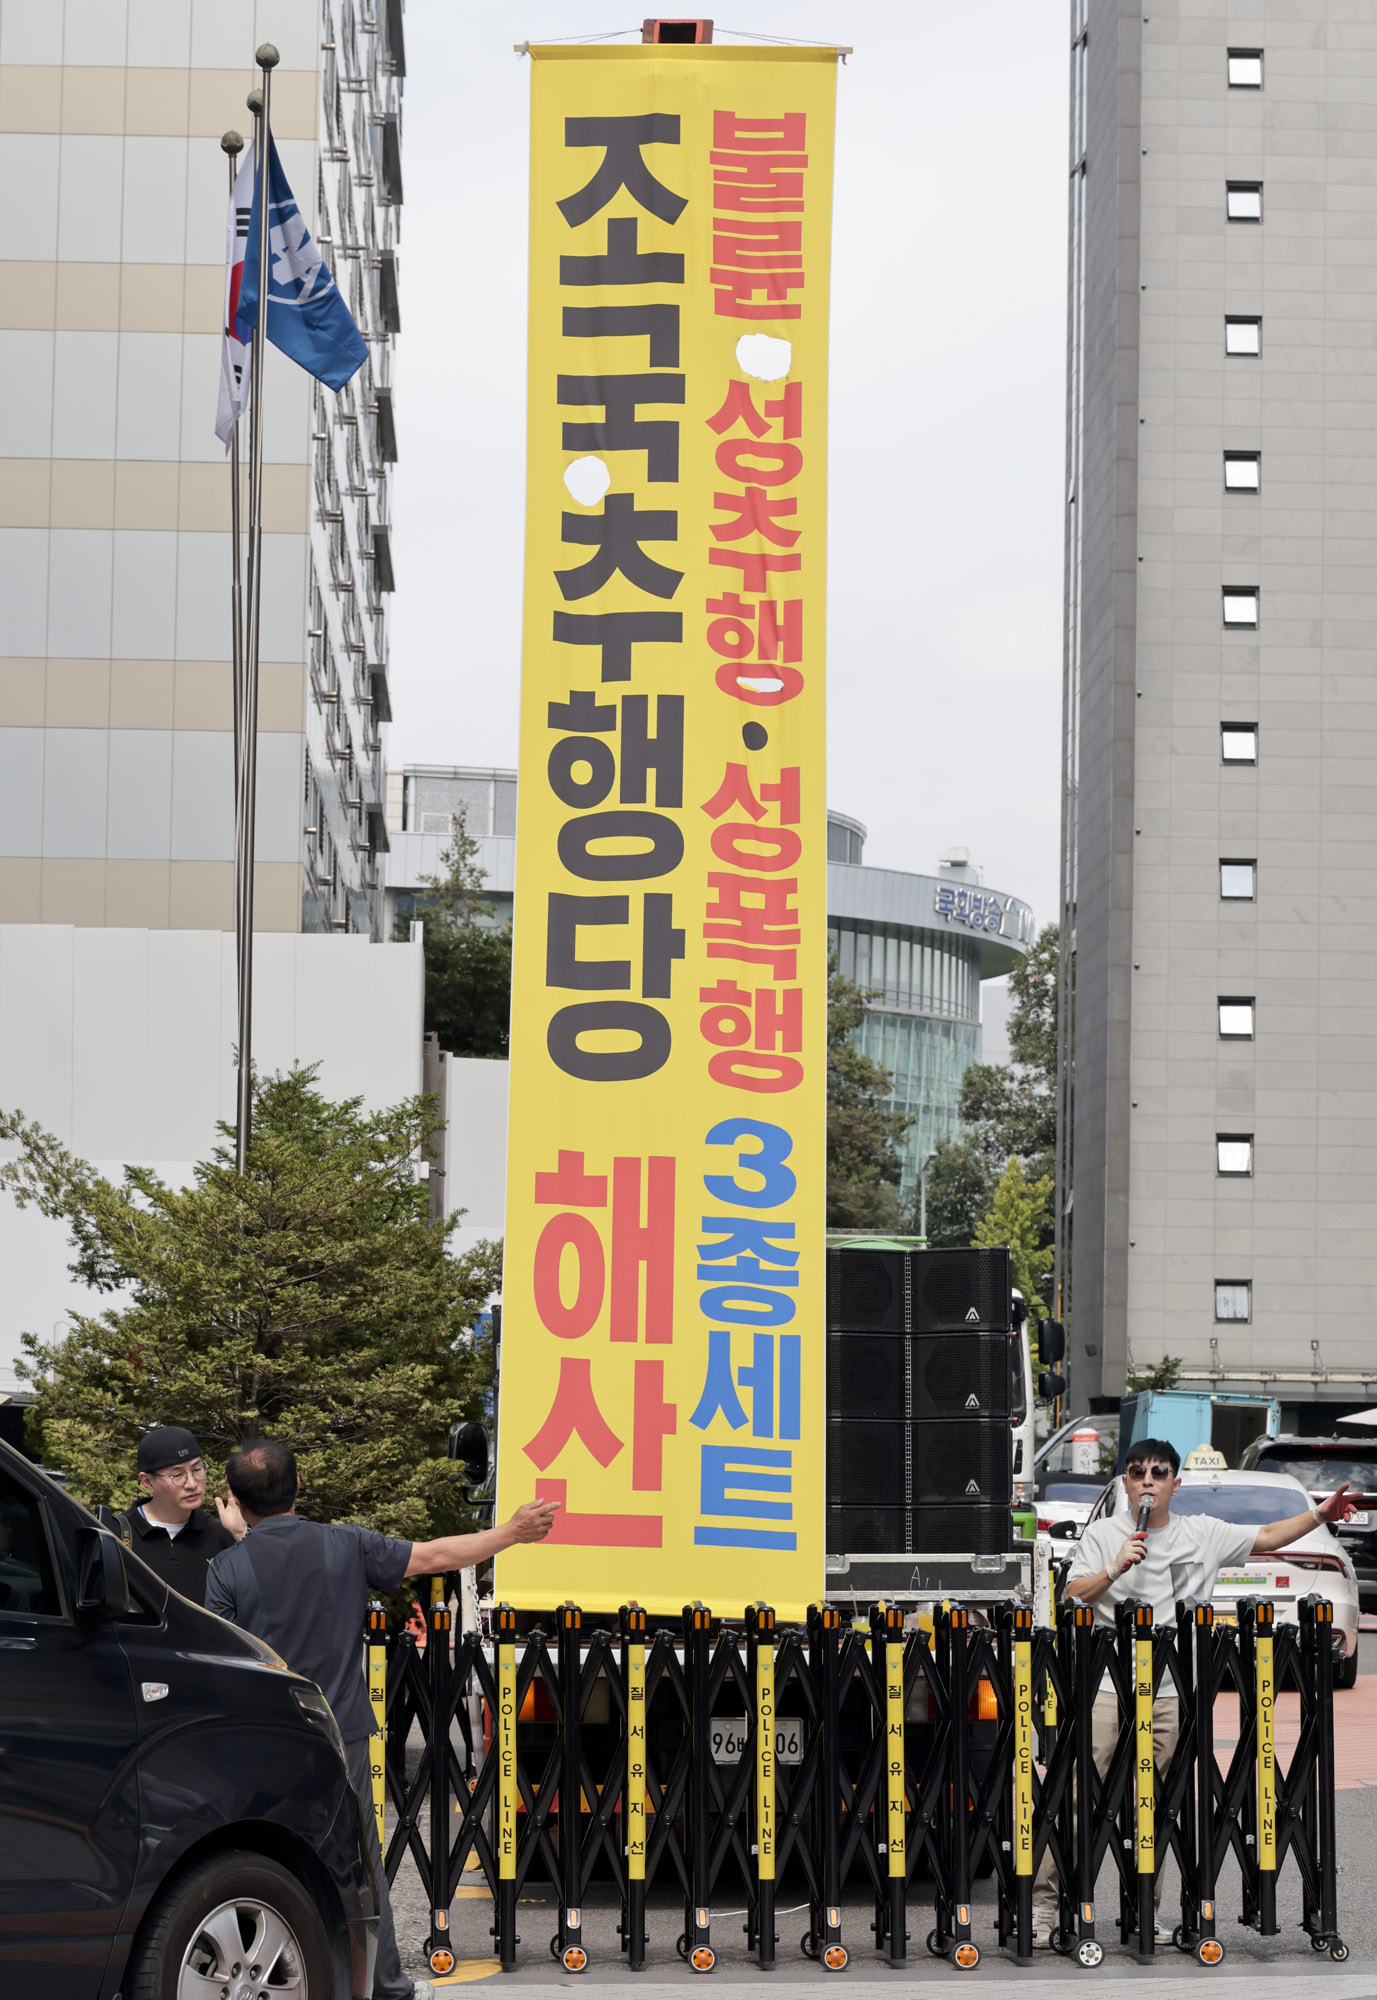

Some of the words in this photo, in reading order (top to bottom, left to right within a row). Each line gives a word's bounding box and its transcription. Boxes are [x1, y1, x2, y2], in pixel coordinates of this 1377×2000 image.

[546, 112, 689, 1082] 조국추행당
[935, 886, 1001, 932] 국회방송
[522, 1149, 677, 1548] 해산
[689, 1117, 802, 1551] 3종세트
[1194, 1457, 1220, 1466] TAXI
[501, 1687, 512, 1777] POLICE
[761, 1687, 772, 1777] POLICE
[888, 1685, 904, 1853] 질서유지선
[1019, 1684, 1029, 1774] POLICE
[1137, 1682, 1153, 1850] 질서유지선
[1261, 1680, 1272, 1769] POLICE
[630, 1686, 644, 1855] 질서유지선
[1264, 1786, 1273, 1845] LINE
[503, 1795, 512, 1855] LINE
[763, 1795, 772, 1855] LINE
[1021, 1791, 1029, 1851] LINE
